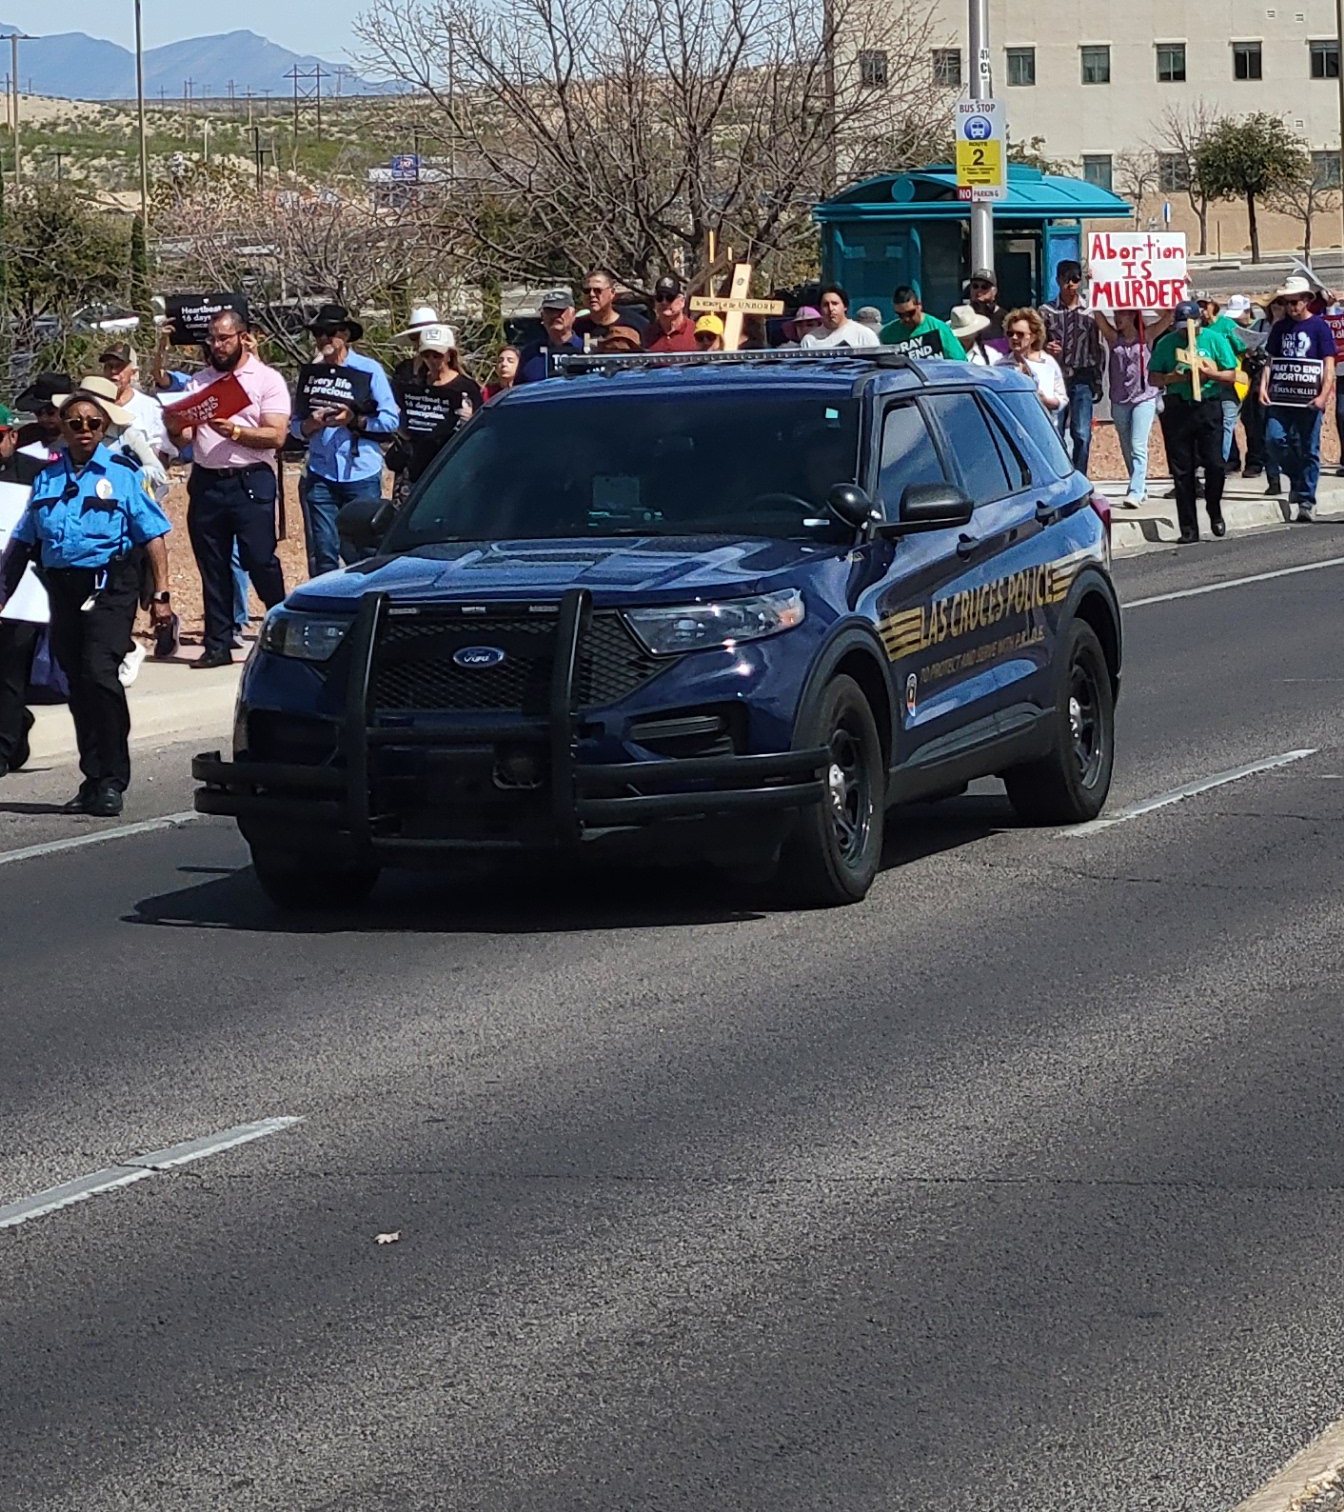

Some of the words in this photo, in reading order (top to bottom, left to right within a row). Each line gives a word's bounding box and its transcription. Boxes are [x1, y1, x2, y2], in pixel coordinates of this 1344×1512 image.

[959, 104, 974, 112] BUS
[976, 104, 995, 112] STOP
[973, 149, 984, 165] 2
[959, 189, 971, 198] NO
[1091, 234, 1184, 260] Abortion
[1121, 260, 1152, 280] IS
[1092, 279, 1184, 308] MURDER
[900, 336, 923, 353] RAY
[1289, 364, 1301, 372] TO
[1303, 365, 1321, 375] END
[308, 376, 334, 387] Every
[335, 377, 352, 389] life
[1273, 373, 1316, 383] ABORTION
[920, 598, 948, 647] LAS
[950, 577, 1004, 637] CRUCES
[1006, 564, 1053, 616] POLICE
